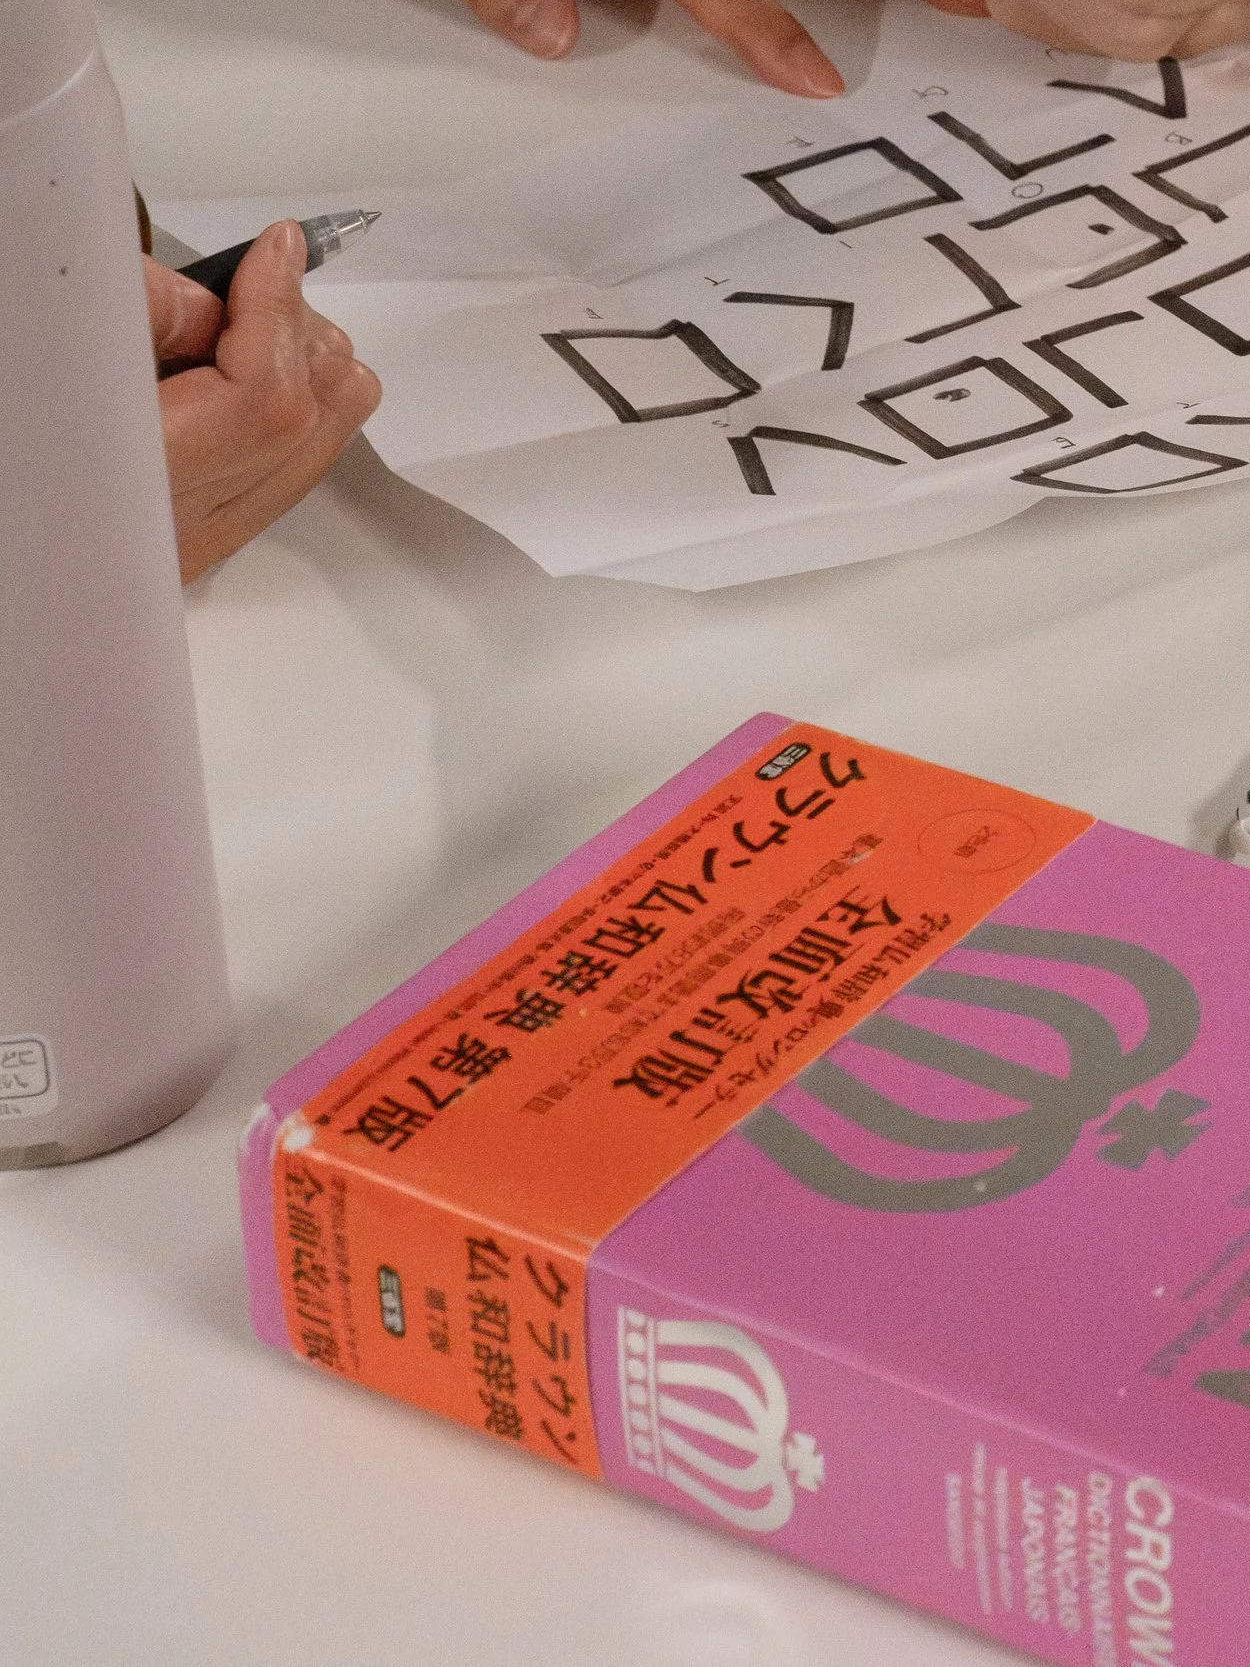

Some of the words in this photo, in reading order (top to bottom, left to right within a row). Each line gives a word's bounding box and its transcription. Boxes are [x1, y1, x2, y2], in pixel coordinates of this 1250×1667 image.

[483, 752, 866, 1034] クラウン仏和辞典
[343, 1033, 512, 1152] 第7版
[612, 891, 904, 1106] 全面改訂版
[465, 1236, 525, 1440] 仏和辞典
[523, 1254, 579, 1465] クラウン
[1124, 1475, 1174, 1667] CROW
